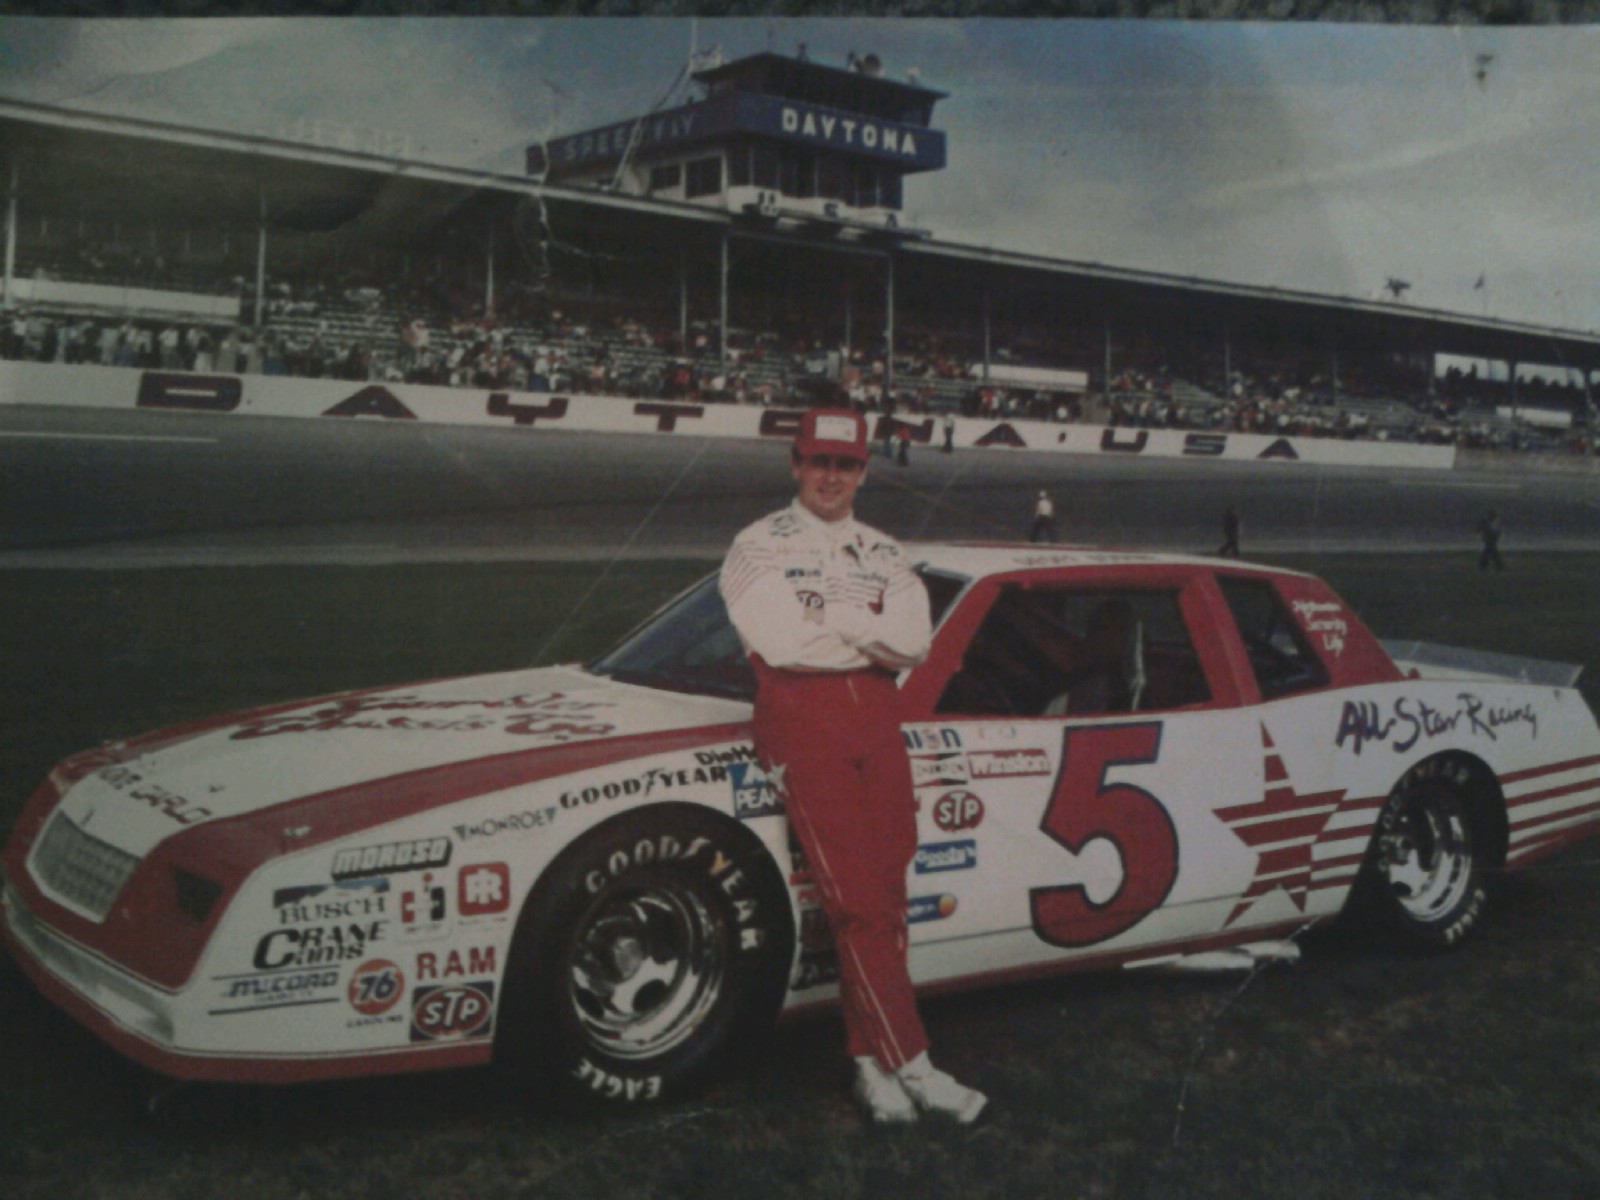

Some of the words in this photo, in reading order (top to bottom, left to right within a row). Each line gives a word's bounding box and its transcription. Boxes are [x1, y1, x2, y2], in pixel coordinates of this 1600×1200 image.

[781, 107, 917, 156] DAYTONA
[1101, 428, 1300, 461] USA
[1456, 692, 1537, 741] Racing
[559, 764, 728, 810] GOODYEAR
[937, 793, 981, 826] STP
[1029, 720, 1180, 949] 5
[279, 896, 386, 925] BUSCH
[585, 835, 758, 951] GOODYEAR
[416, 946, 496, 980] RAM
[357, 969, 398, 1003] 76
[422, 990, 482, 1028] STP
[572, 1057, 663, 1101] EAGLE
